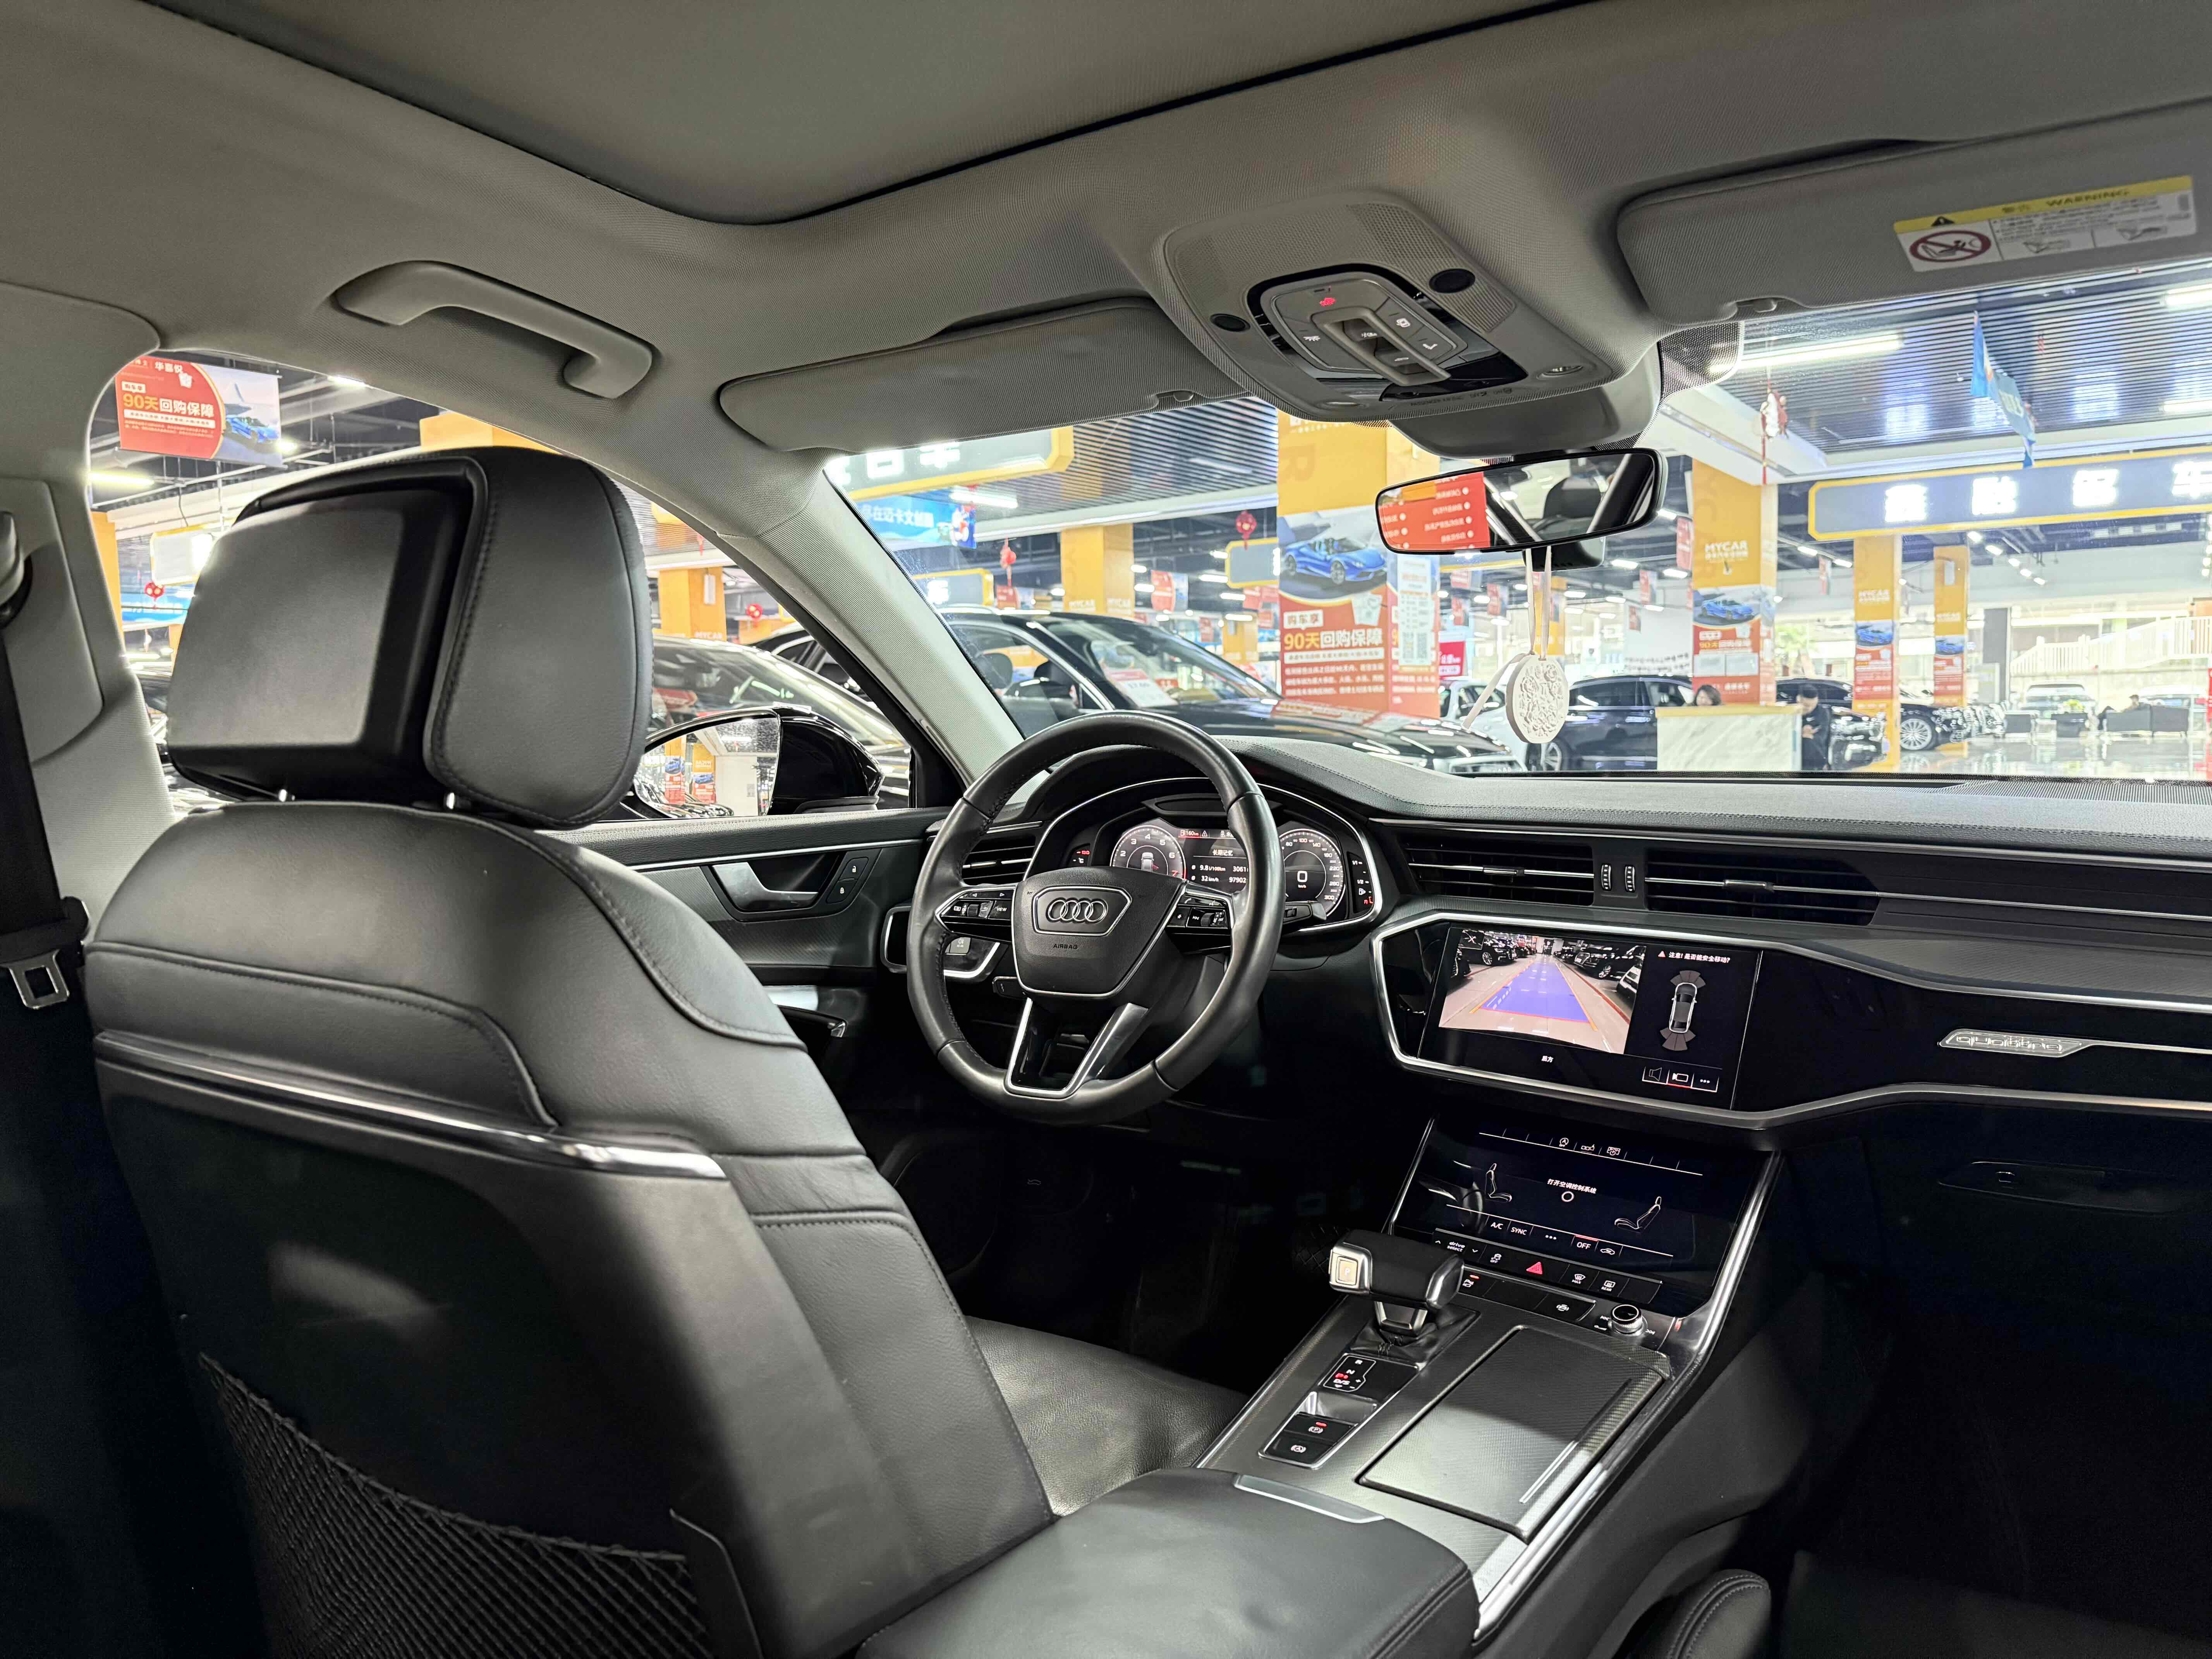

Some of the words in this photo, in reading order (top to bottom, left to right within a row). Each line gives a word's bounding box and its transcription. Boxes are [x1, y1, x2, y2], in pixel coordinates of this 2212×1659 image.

[2046, 190, 2129, 207] WARNING
[123, 393, 214, 417] 90天回购保障
[1705, 541, 1748, 552] MYCAR
[1284, 628, 1382, 650] 90天回购保障
[1297, 871, 1307, 883] 0
[1956, 1036, 2062, 1053] quattro
[1547, 1178, 1597, 1194] 打开空调控制系统
[1511, 1227, 1527, 1235] SYNC
